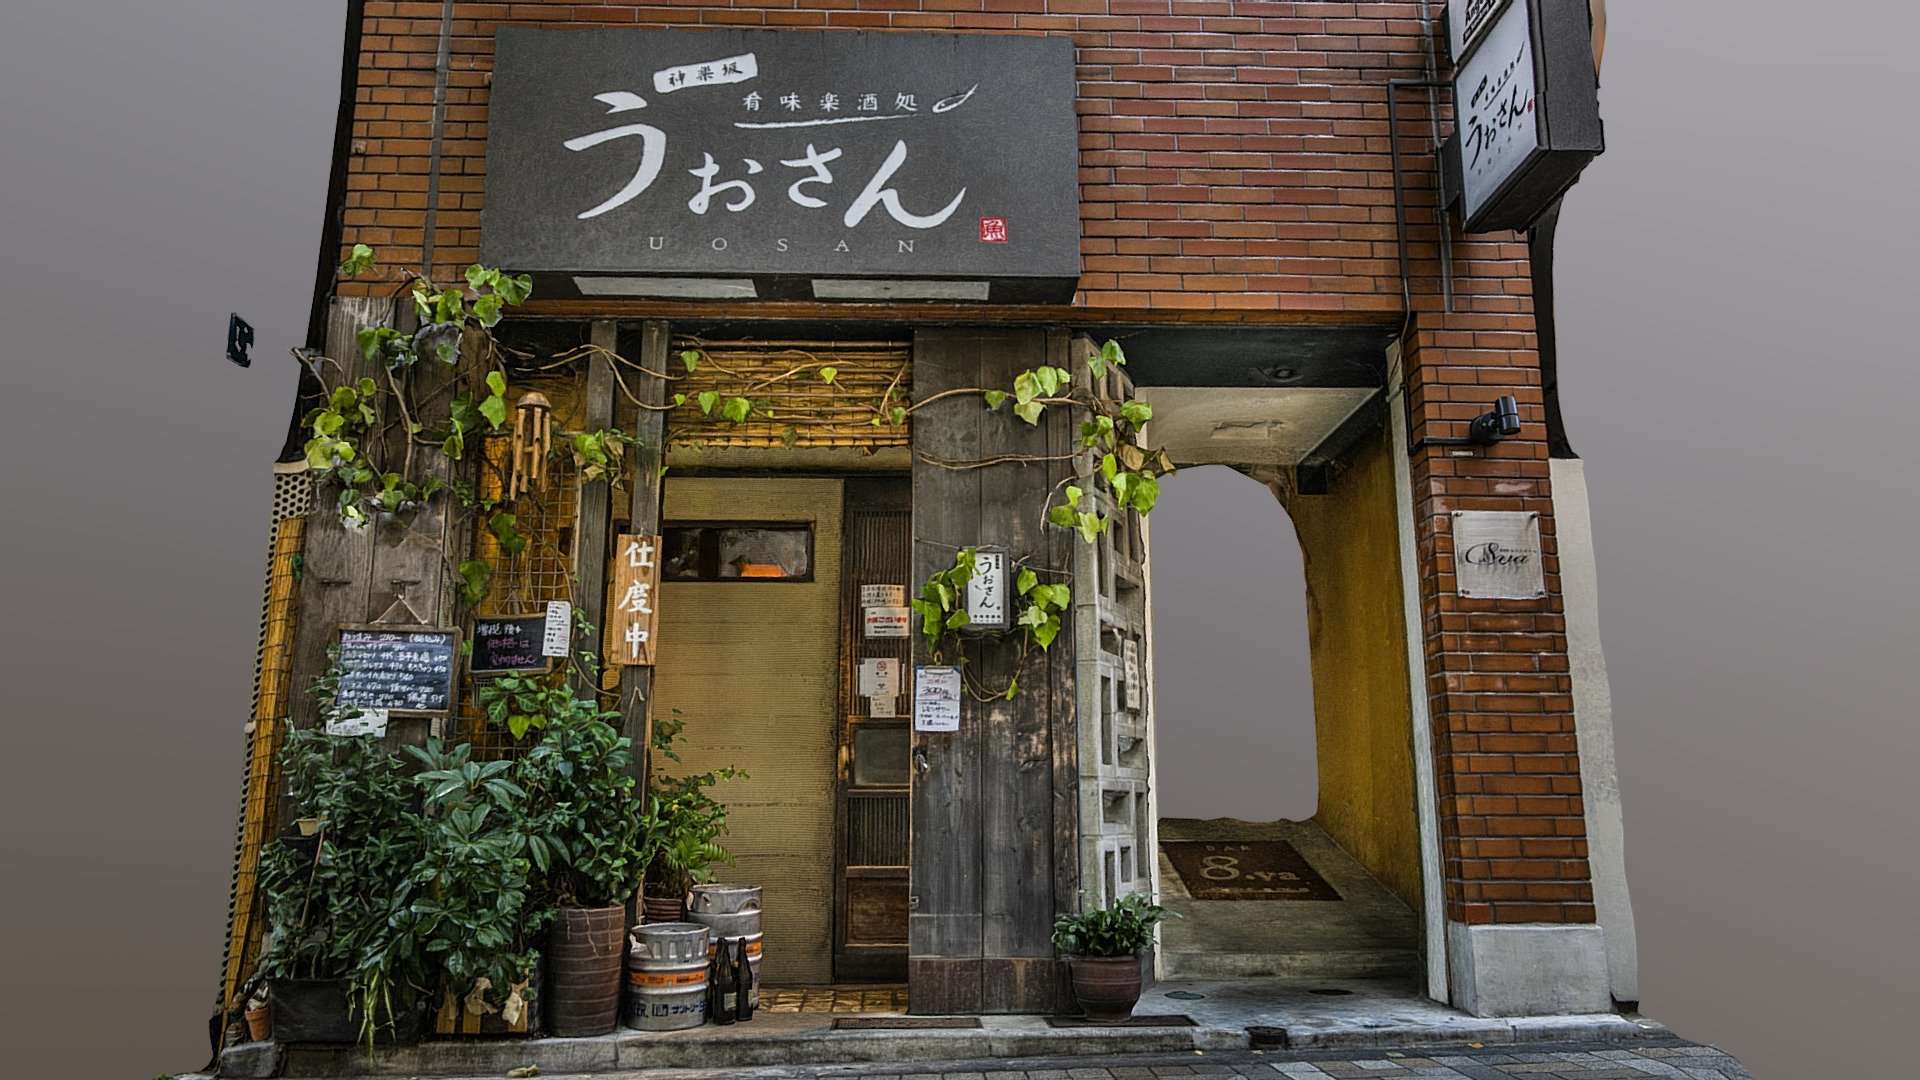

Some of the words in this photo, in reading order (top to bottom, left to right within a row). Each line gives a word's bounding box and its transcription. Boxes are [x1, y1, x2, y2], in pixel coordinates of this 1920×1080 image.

[668, 61, 743, 87] 神楽坂
[742, 90, 919, 114] 肴味楽酒処
[1465, 84, 1529, 171] うおさん
[562, 90, 967, 229] うおさん
[648, 236, 917, 255] UOSAN
[618, 541, 655, 658] 仕度中
[980, 557, 995, 608] うおさん
